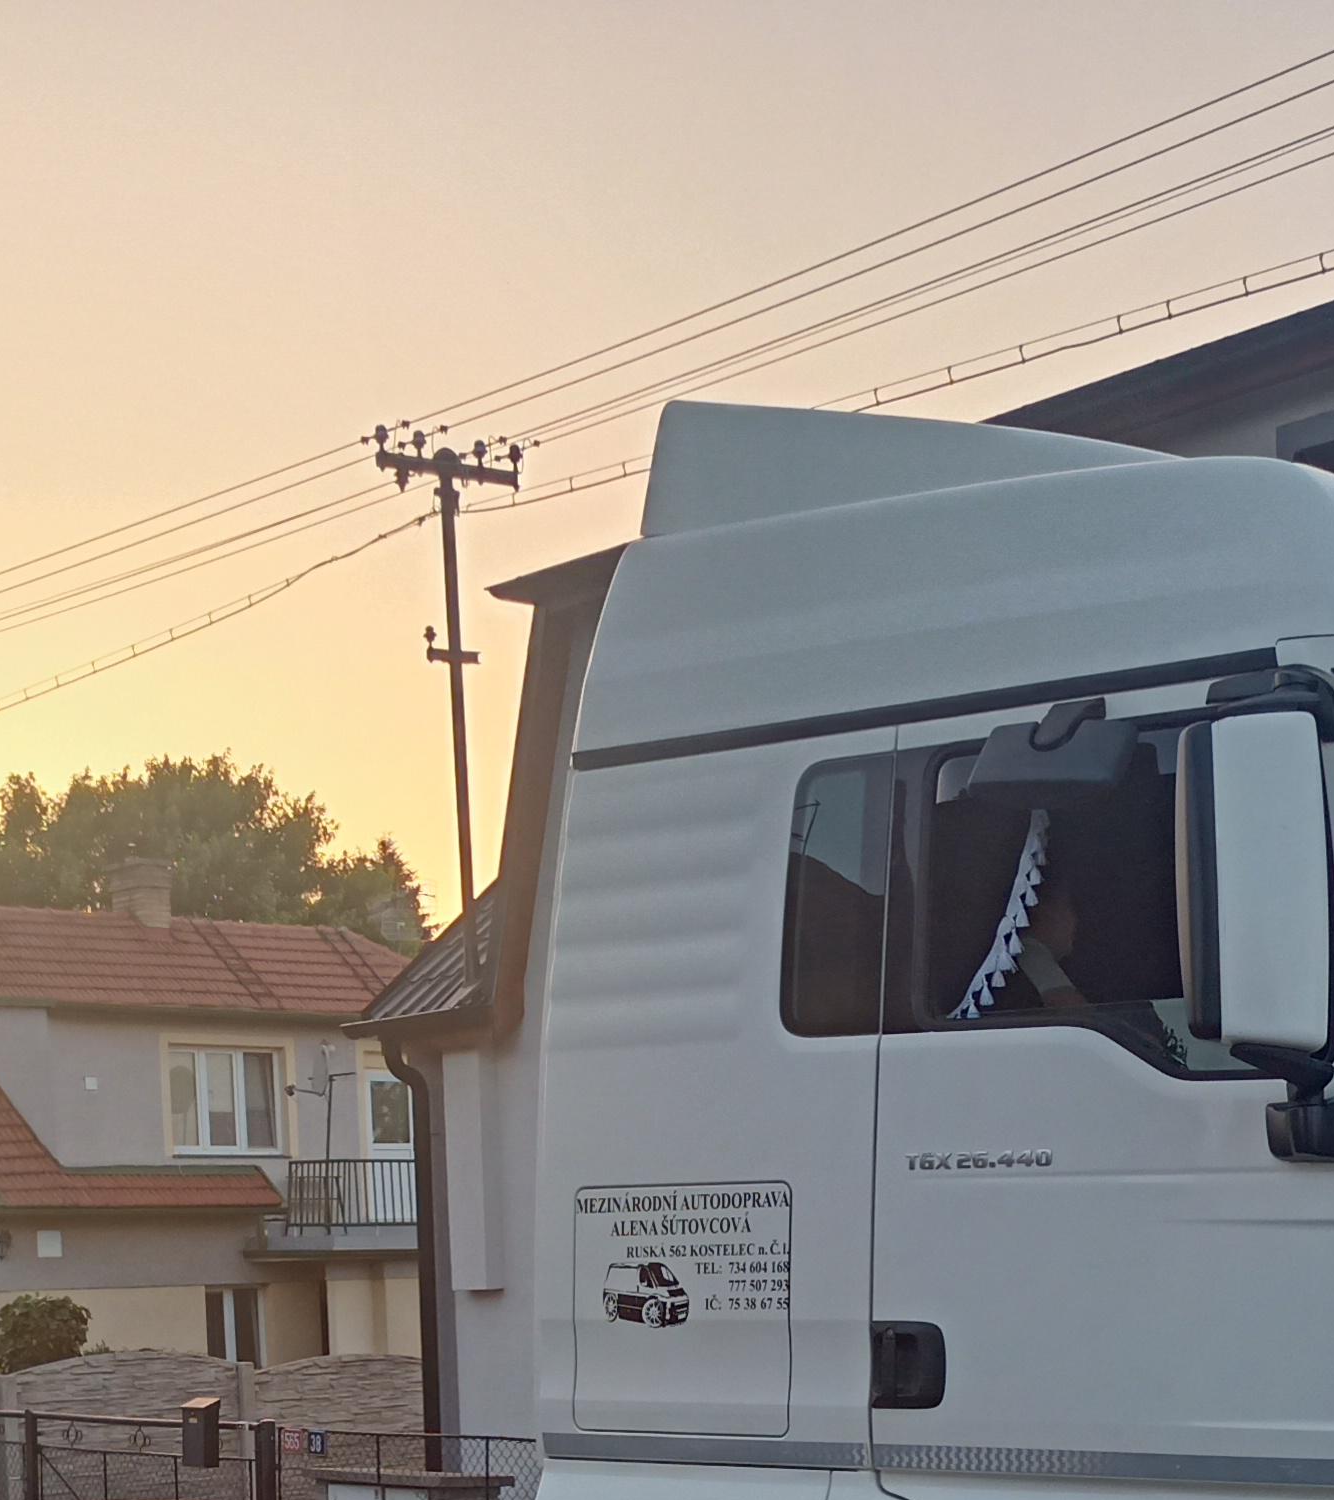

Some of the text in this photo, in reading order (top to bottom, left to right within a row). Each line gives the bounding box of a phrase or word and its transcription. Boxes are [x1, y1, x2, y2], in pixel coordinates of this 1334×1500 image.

[904, 1148, 1053, 1171] TGX 26.440
[576, 1190, 790, 1214] MEZINÁRODNÍ AUTODOPRAVA
[611, 1211, 751, 1236] ALENA ŠÚTOVCOVÁ
[669, 1245, 687, 1257] 562
[690, 1242, 756, 1257] KOSTELEC
[728, 1261, 746, 1274] 734
[749, 1261, 768, 1274] 604
[771, 1260, 790, 1273] 168
[728, 1279, 789, 1292] 777 507 293
[728, 1297, 740, 1310] 75
[743, 1297, 756, 1310] 38
[760, 1297, 773, 1310] 67
[776, 1297, 789, 1310] 55
[310, 1434, 322, 1453] 38
